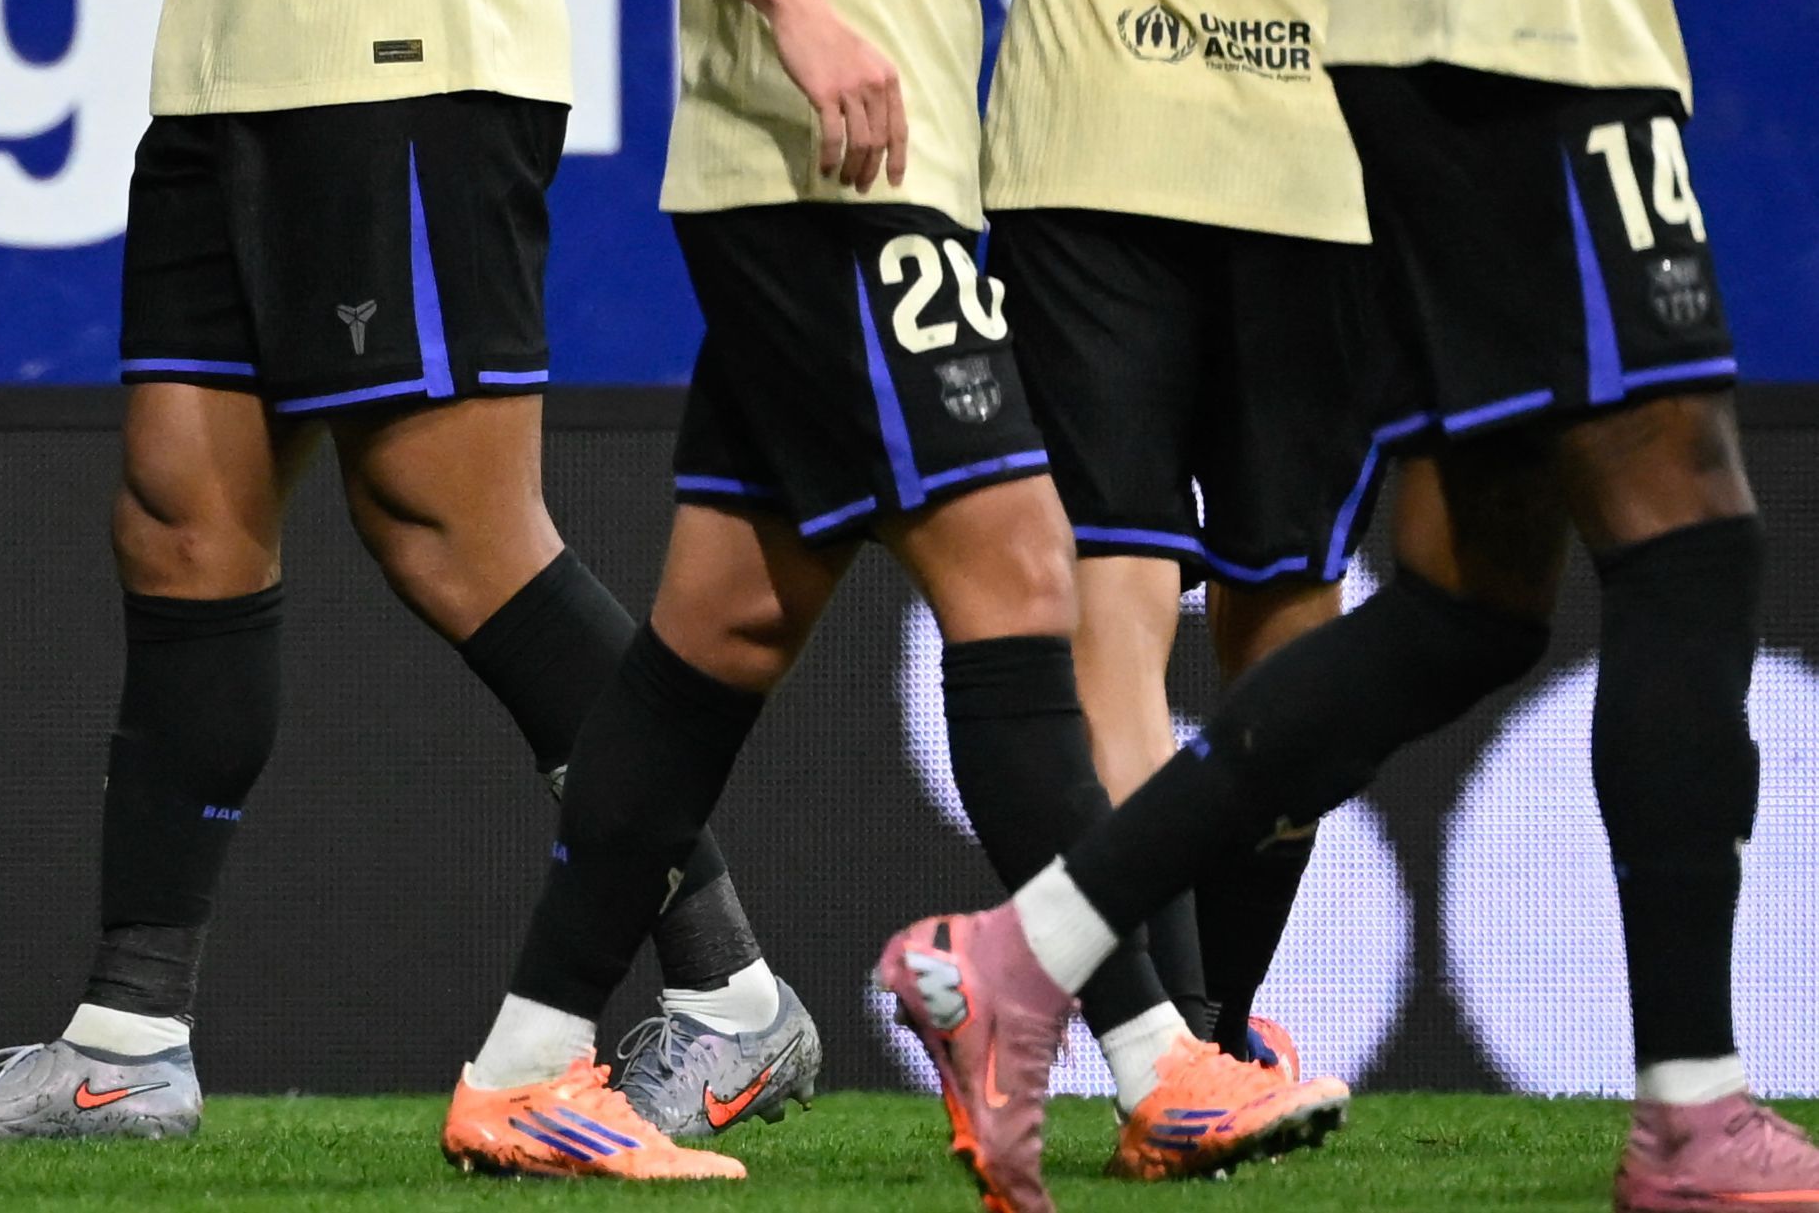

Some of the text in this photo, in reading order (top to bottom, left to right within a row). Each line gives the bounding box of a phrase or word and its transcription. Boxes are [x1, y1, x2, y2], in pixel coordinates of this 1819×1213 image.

[1199, 12, 1311, 45] UNHCR
[1203, 36, 1311, 71] ACNUR
[1585, 115, 1708, 252] 14
